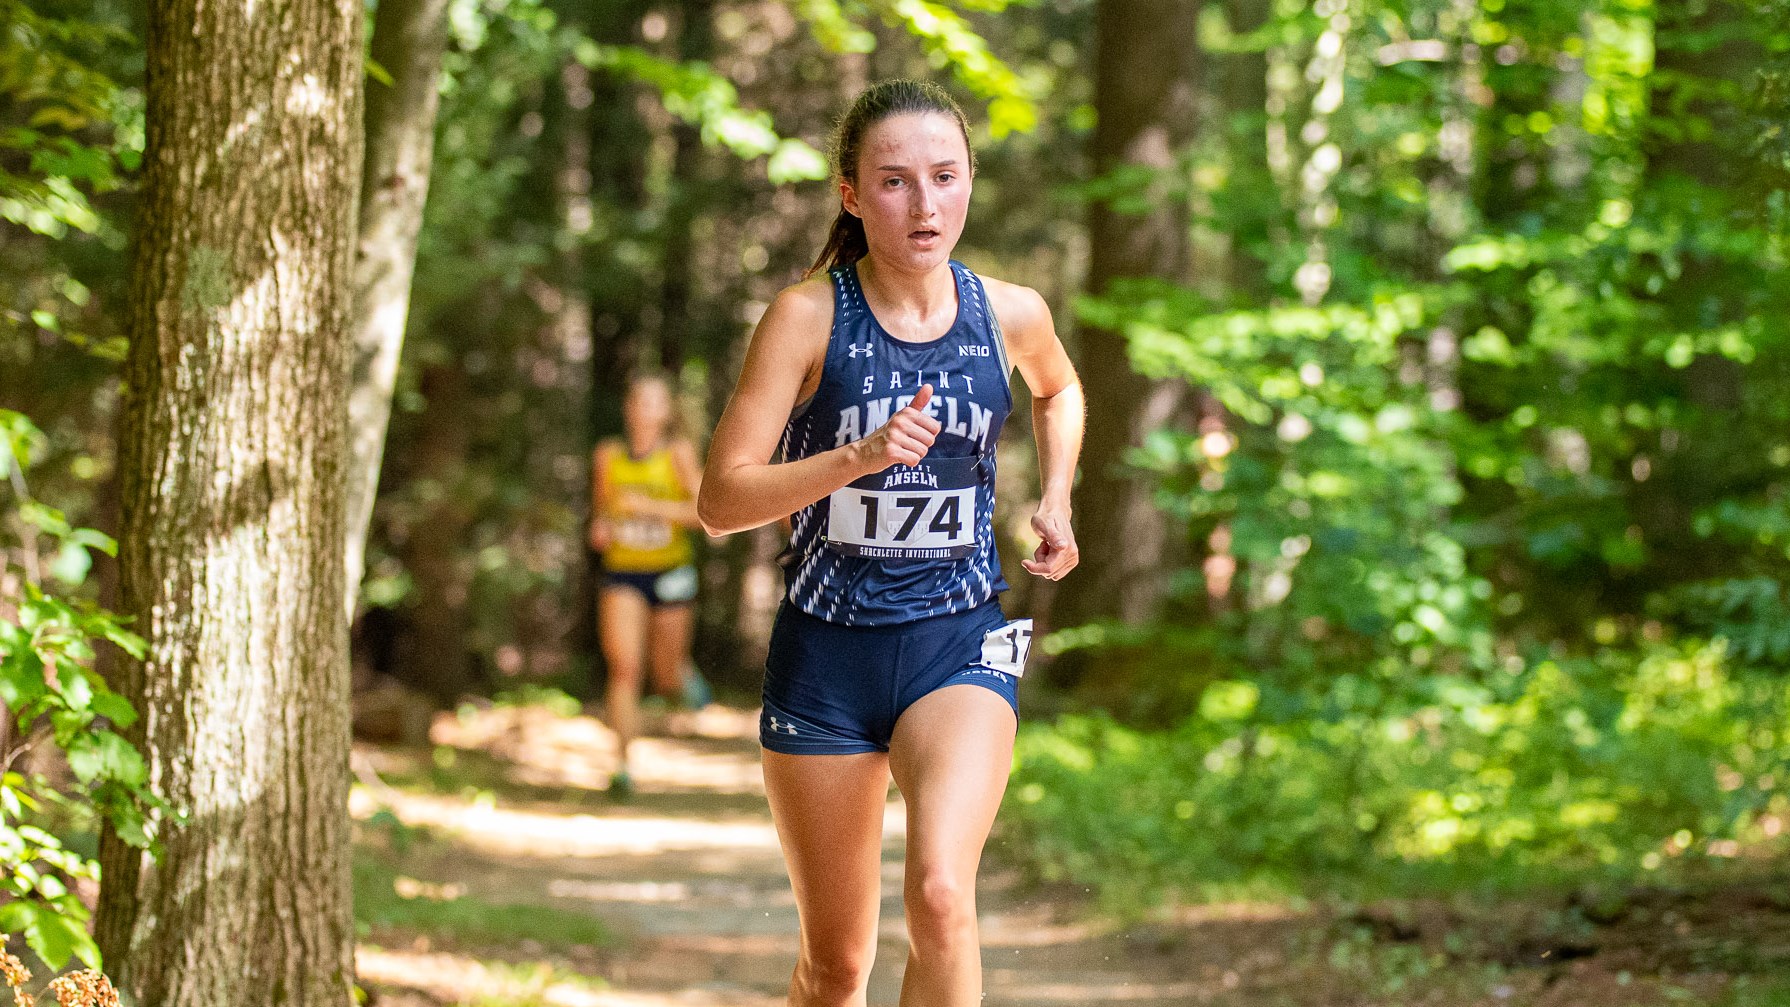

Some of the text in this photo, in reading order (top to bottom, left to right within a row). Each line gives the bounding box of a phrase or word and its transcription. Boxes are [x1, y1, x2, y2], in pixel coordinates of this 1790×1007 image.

[958, 345, 990, 357] NE10
[862, 370, 974, 395] SAINT
[883, 471, 939, 490] ANSELM
[860, 495, 963, 542] 174
[905, 548, 951, 559] INVITATIONAL
